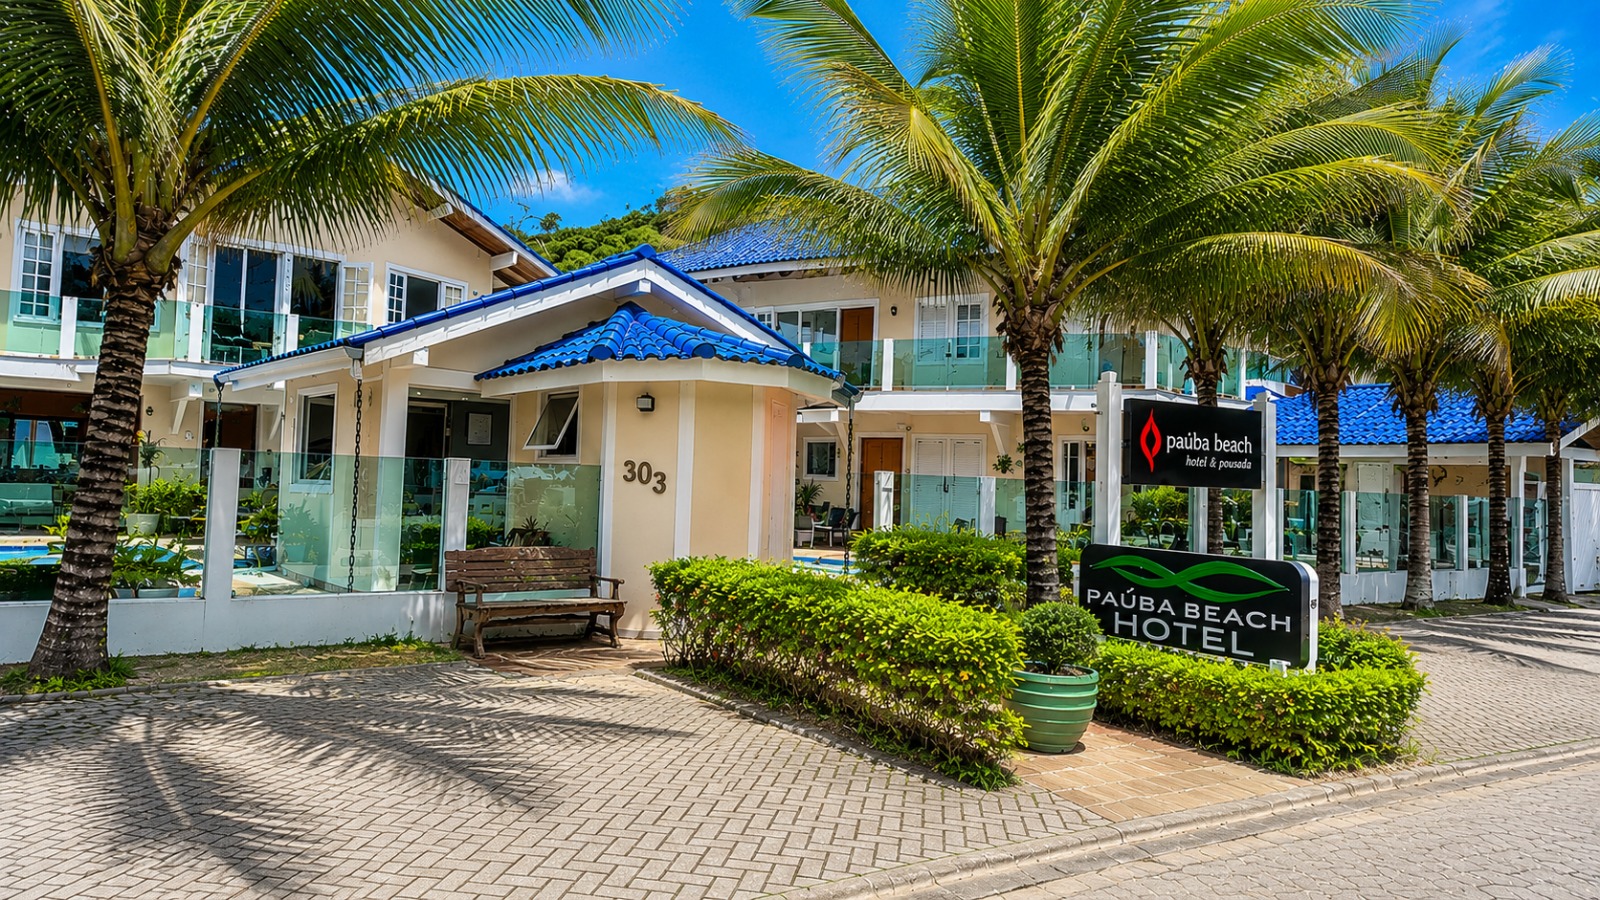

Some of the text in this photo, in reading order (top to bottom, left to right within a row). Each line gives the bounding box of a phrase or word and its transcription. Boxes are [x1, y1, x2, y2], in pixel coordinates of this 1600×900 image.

[1166, 431, 1252, 454] paúba beach
[622, 459, 667, 495] 303
[1185, 455, 1252, 471] hotel & pousada
[1086, 587, 1291, 633] PAÚBA BEACH
[1114, 612, 1254, 657] HOTEL
